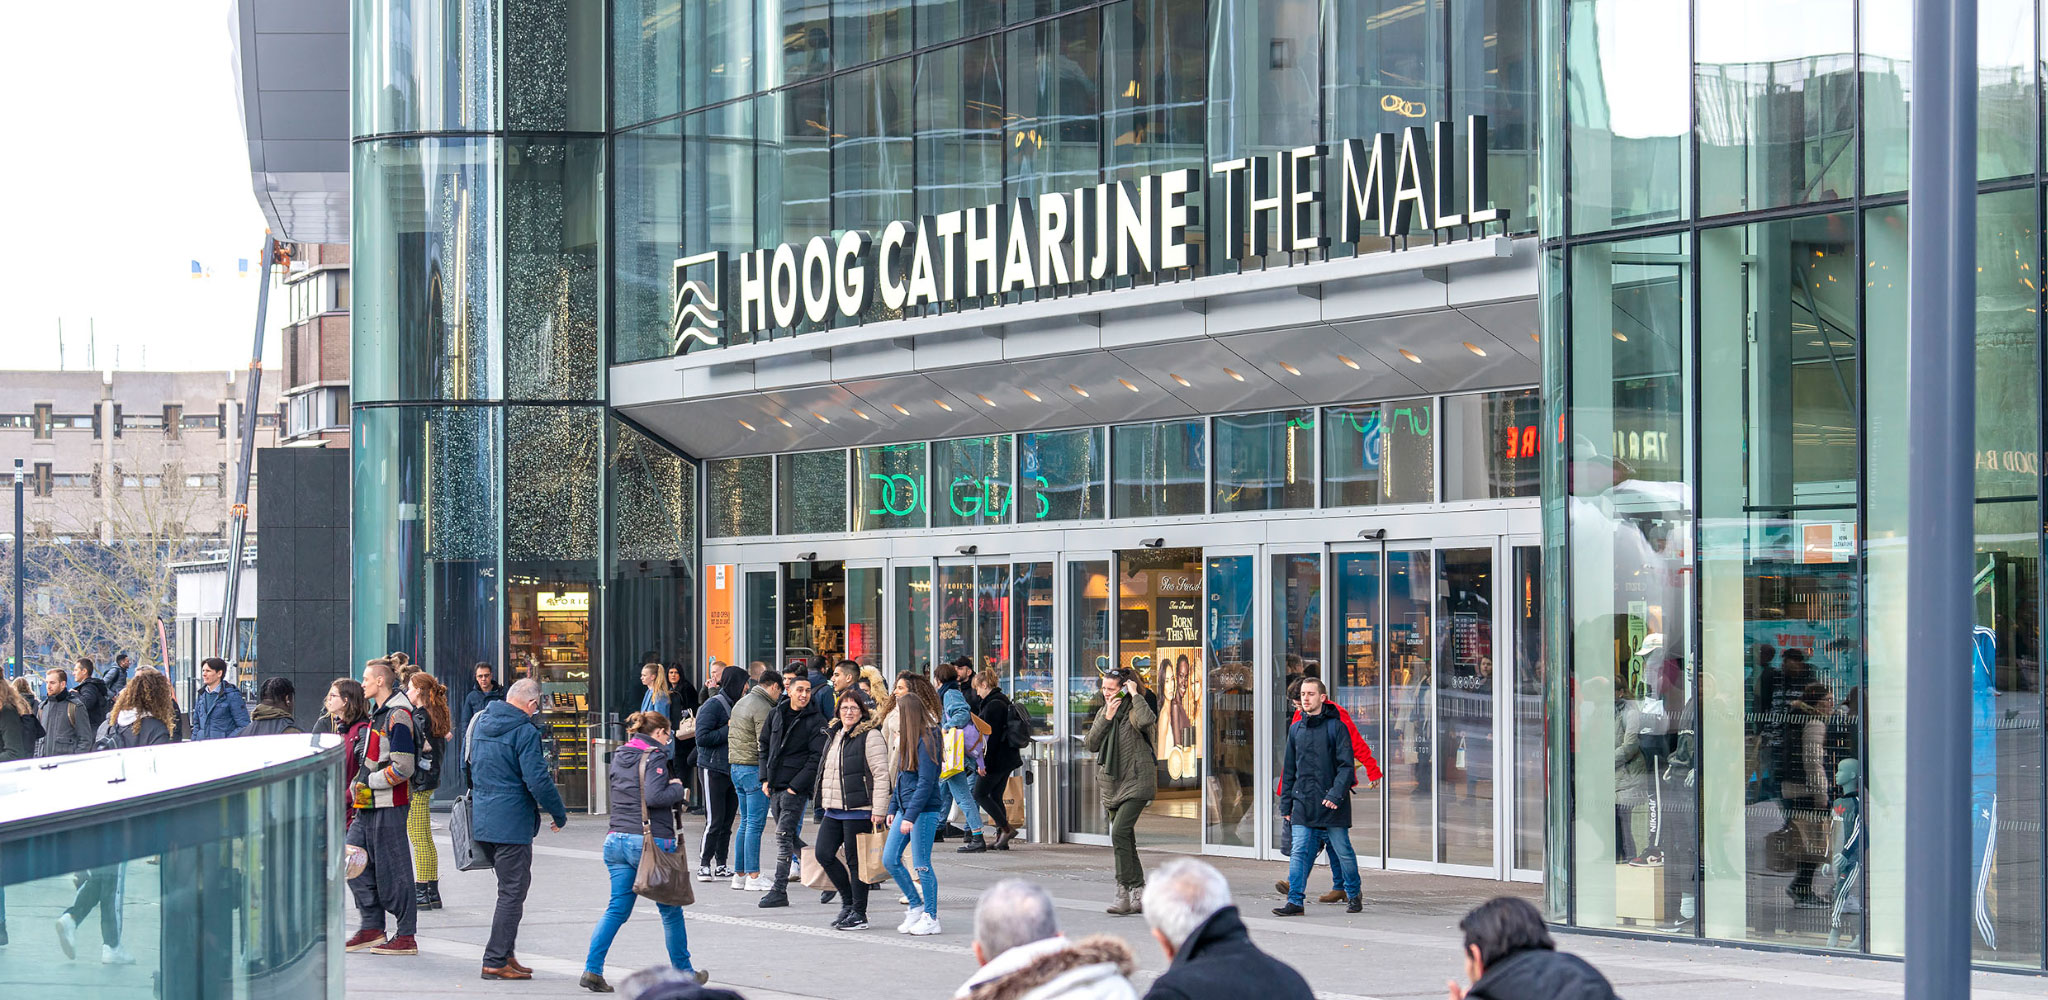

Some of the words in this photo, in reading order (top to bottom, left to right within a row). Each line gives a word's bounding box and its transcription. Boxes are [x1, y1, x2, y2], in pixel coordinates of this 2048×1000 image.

[740, 230, 872, 333] HOOG
[879, 169, 1197, 311] CATHARIJNE
[1213, 145, 1328, 260] THE
[1341, 115, 1508, 243] MALL
[1172, 614, 1193, 628] BORN
[1166, 627, 1183, 641] THIS
[1183, 627, 1199, 641] WAY
